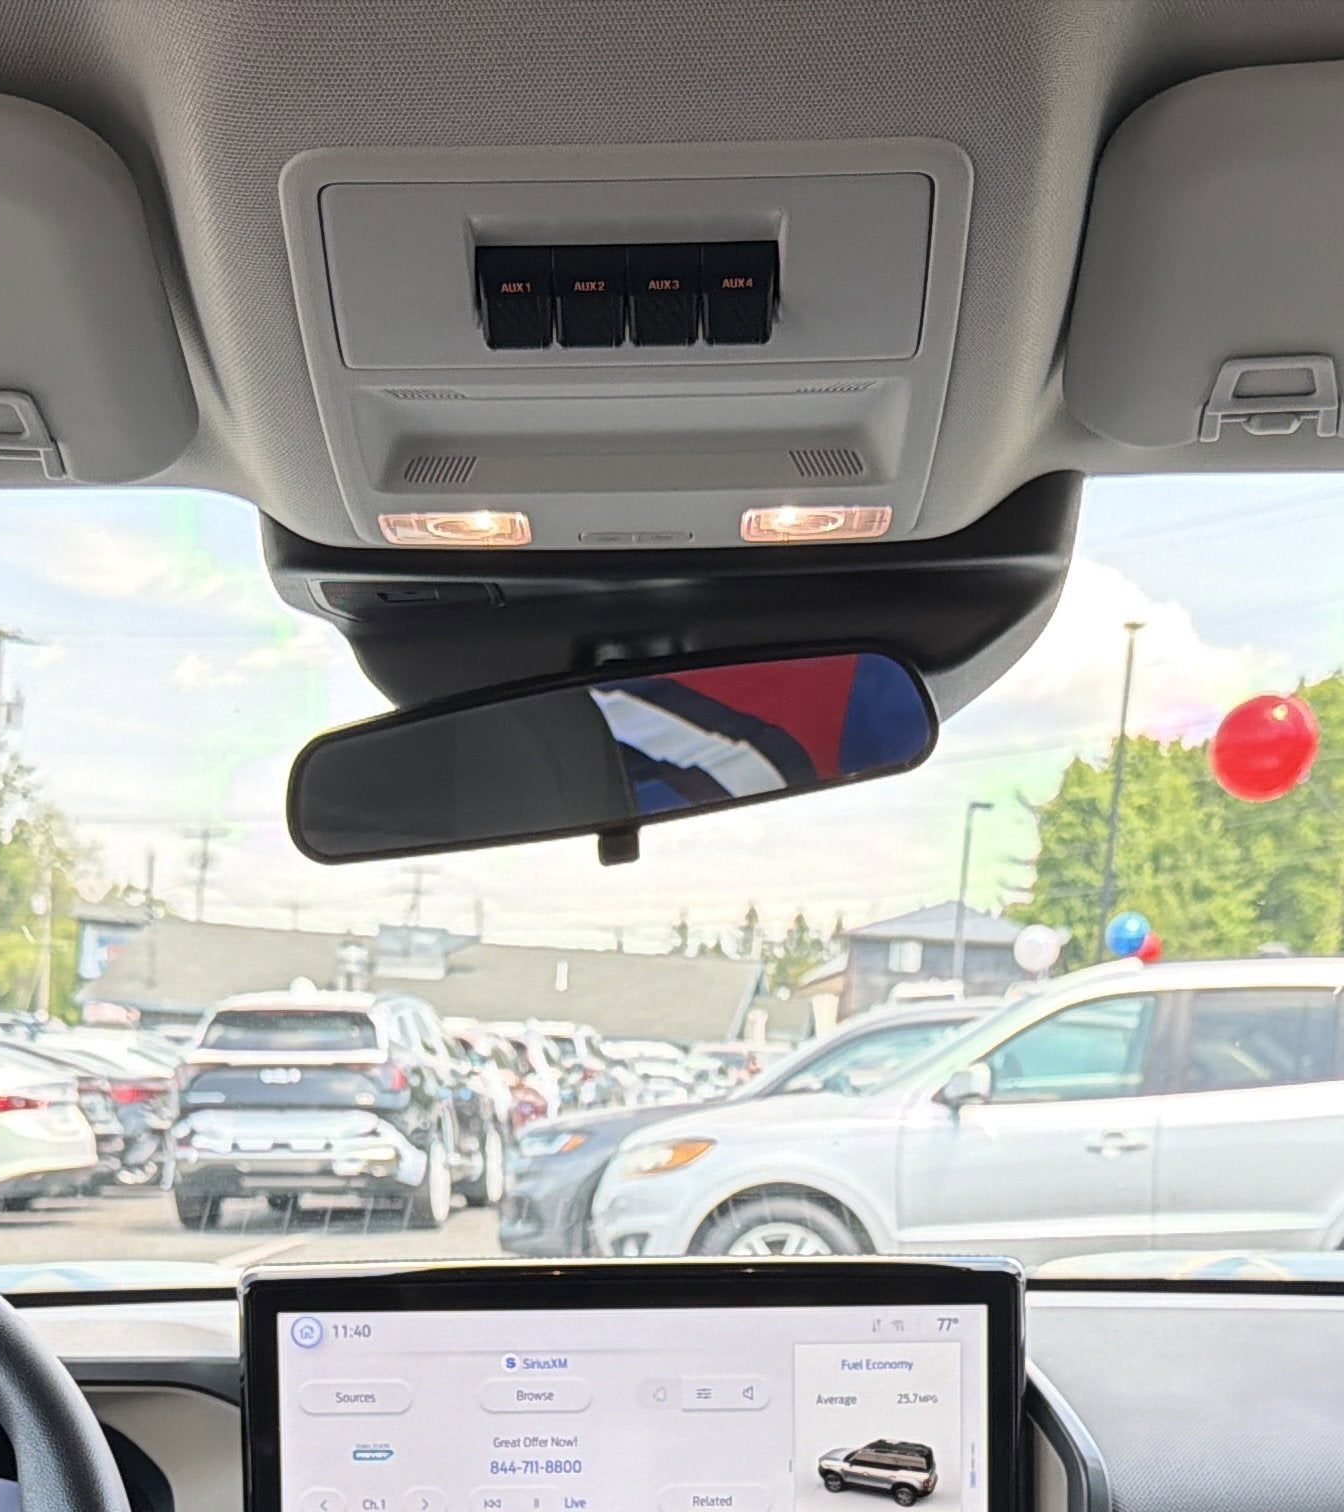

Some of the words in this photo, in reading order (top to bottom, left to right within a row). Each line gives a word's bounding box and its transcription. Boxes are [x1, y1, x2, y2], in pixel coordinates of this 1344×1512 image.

[574, 280, 605, 292] AUX2
[648, 279, 679, 291] AUX3
[722, 277, 753, 290] AUX4
[333, 1324, 372, 1339] 11:40
[522, 1358, 568, 1369] SiriusXM
[841, 1359, 863, 1370] Fuel
[865, 1359, 914, 1372] Economy
[335, 1391, 376, 1403] Sources
[516, 1390, 554, 1401] Browse
[816, 1394, 857, 1407] Average
[493, 1437, 521, 1448] Great
[523, 1437, 549, 1447] Offer
[551, 1437, 578, 1448] Now!
[490, 1460, 582, 1474] 844-711-8800
[564, 1497, 586, 1509] Live
[692, 1495, 733, 1507] Related
